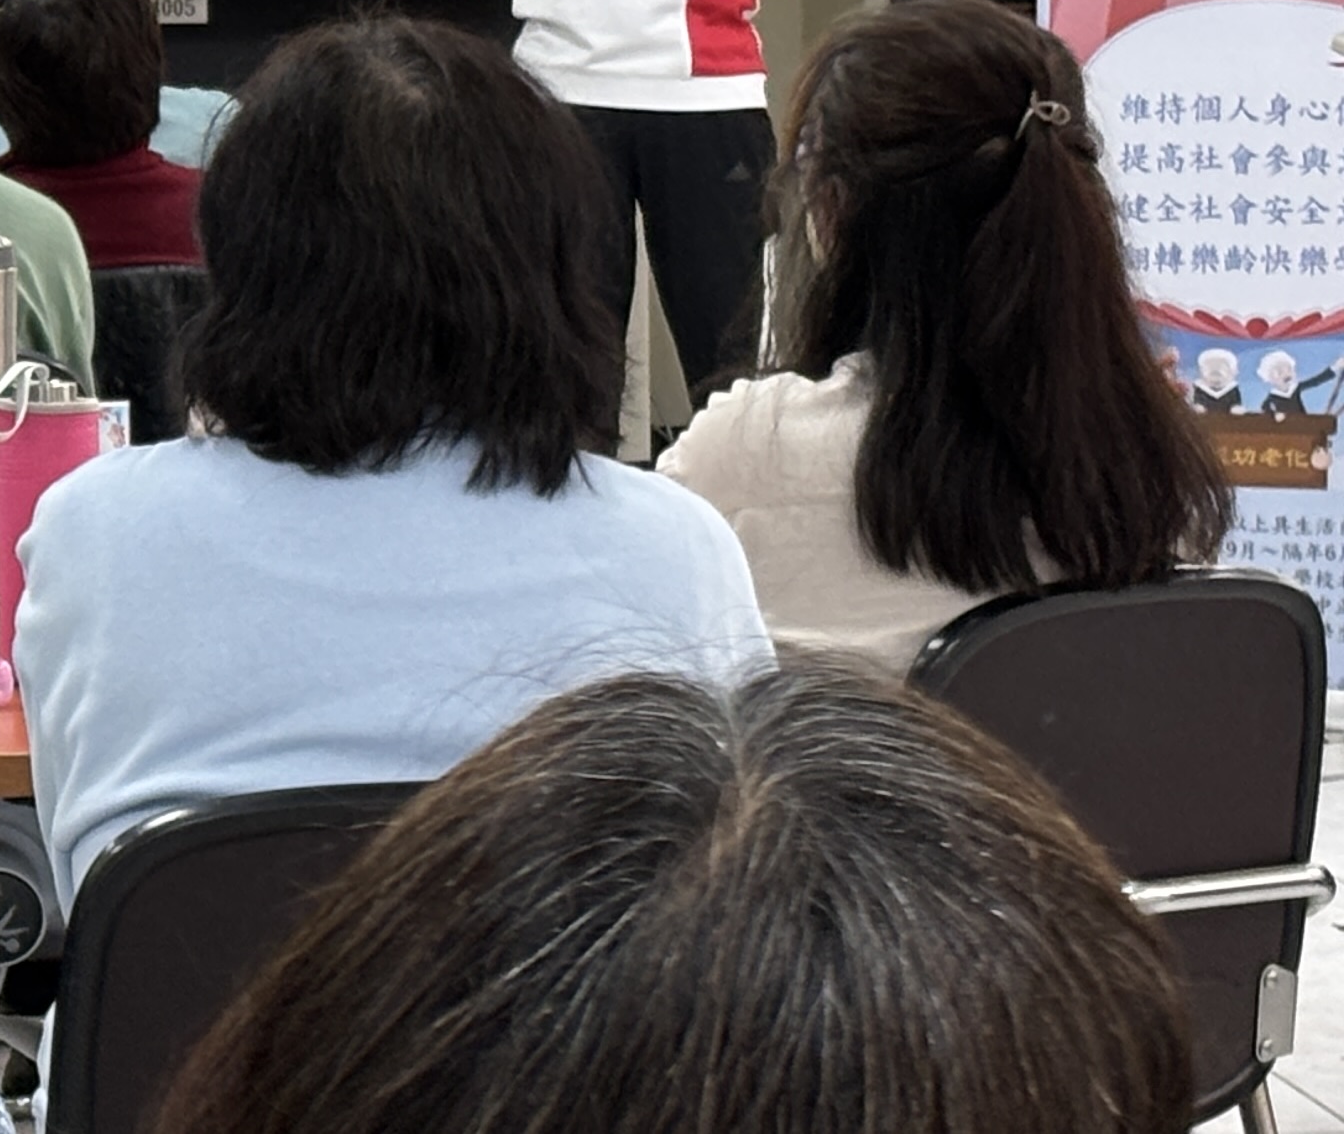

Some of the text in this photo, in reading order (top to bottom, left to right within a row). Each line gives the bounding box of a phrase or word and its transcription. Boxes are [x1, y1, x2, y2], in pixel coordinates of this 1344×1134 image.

[1119, 92, 1344, 126] 維持個人身心
[1119, 141, 1344, 176] 提高社會參與
[1121, 193, 1344, 226] 健全社會安全
[1238, 514, 1344, 537] 上具生活
[1225, 539, 1344, 564] 9月～隔年6
[1294, 569, 1344, 591] 學校
